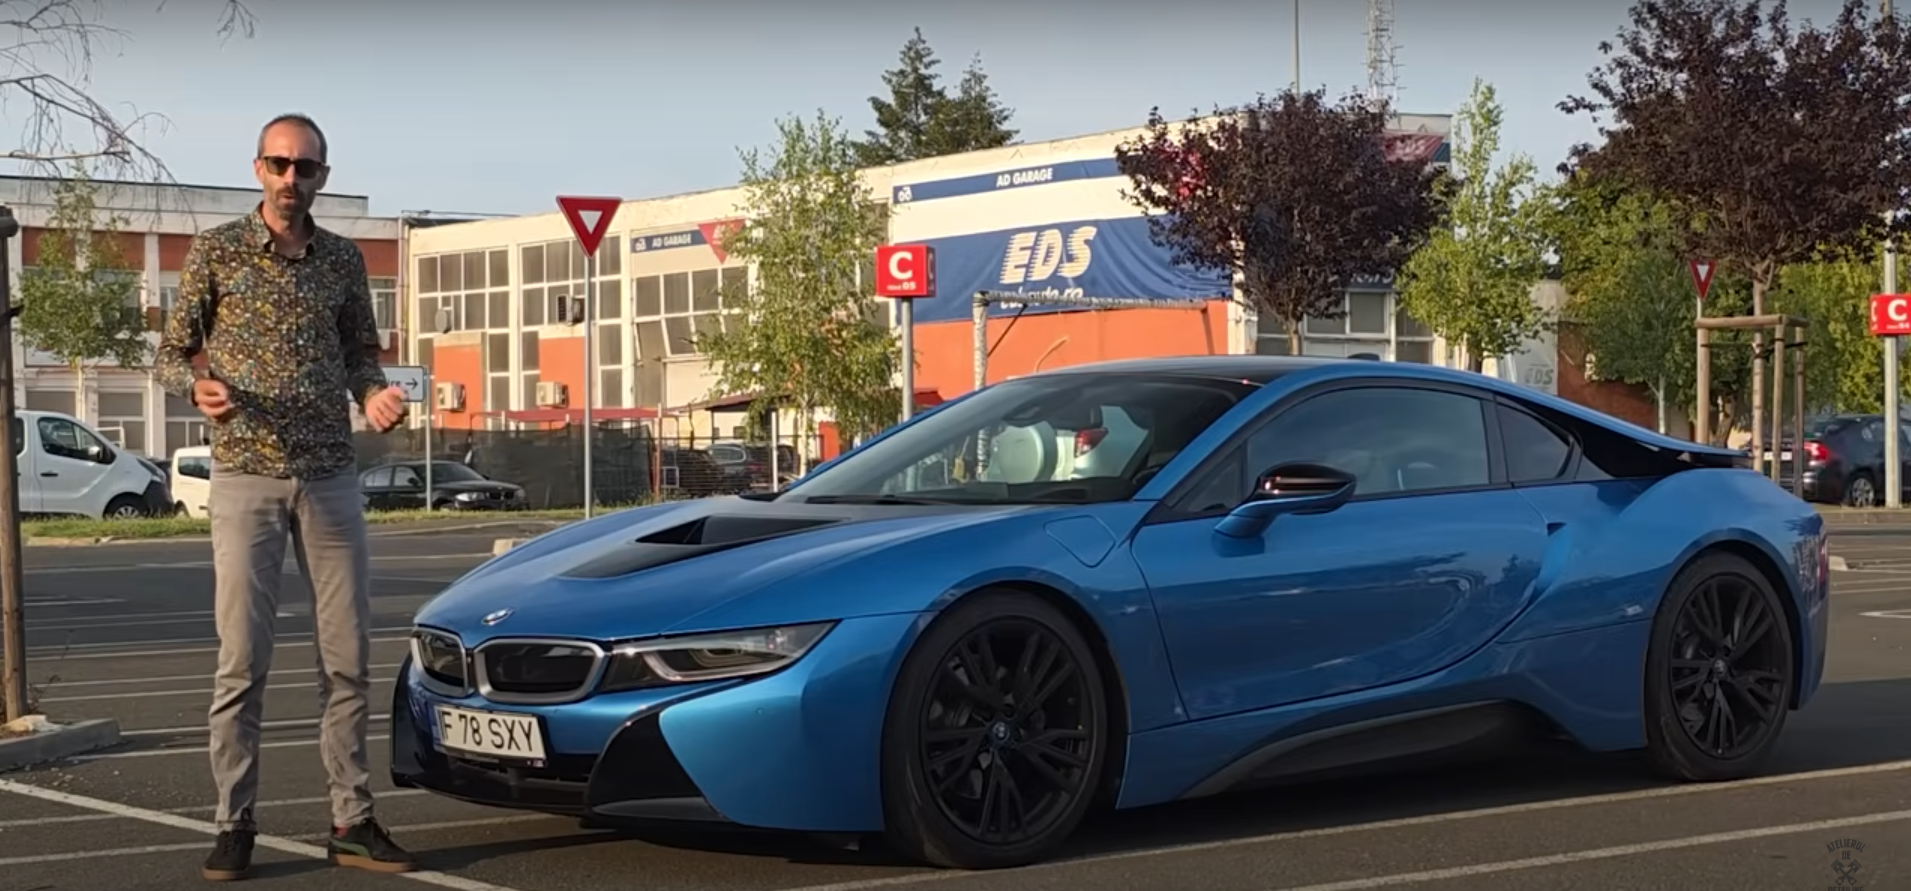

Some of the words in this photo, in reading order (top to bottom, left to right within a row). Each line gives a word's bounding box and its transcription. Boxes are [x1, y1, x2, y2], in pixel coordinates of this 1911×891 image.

[996, 174, 1011, 188] AD
[1013, 167, 1053, 185] GARAGE
[663, 233, 692, 246] GARAGE
[889, 251, 913, 280] C
[999, 226, 1097, 284] EDS
[1887, 299, 1907, 321] C
[458, 713, 483, 746] 78
[488, 718, 532, 752] SXY
